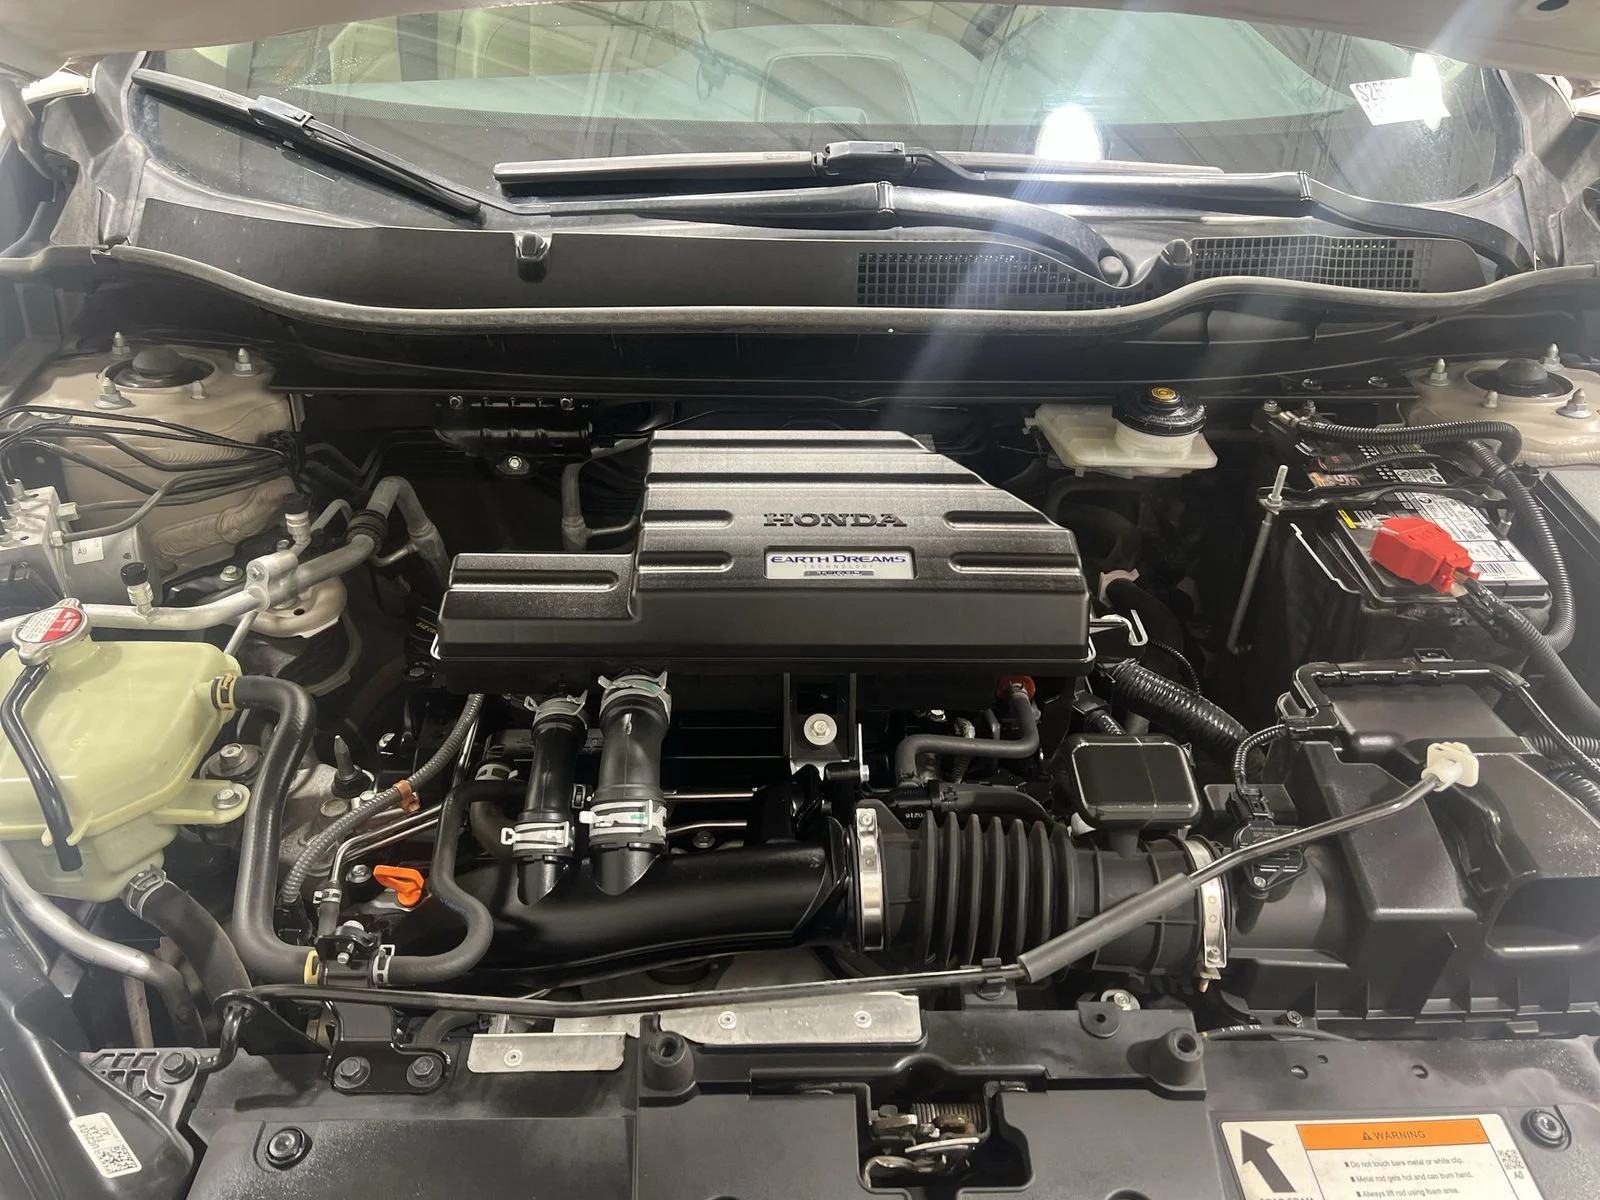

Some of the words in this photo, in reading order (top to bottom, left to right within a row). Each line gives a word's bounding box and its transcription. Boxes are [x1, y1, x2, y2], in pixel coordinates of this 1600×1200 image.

[763, 512, 907, 528] HONDA
[770, 555, 829, 563] EARTH
[833, 554, 906, 563] DREAMS
[1373, 1130, 1426, 1140] WARNING
[1350, 1160, 1360, 1168] Do
[1361, 1160, 1372, 1168] not
[1387, 1175, 1401, 1183] gets
[1363, 1190, 1386, 1199] Always
[1395, 1189, 1407, 1197] rod
[1407, 1189, 1425, 1197] using
[1425, 1187, 1441, 1195] foam
